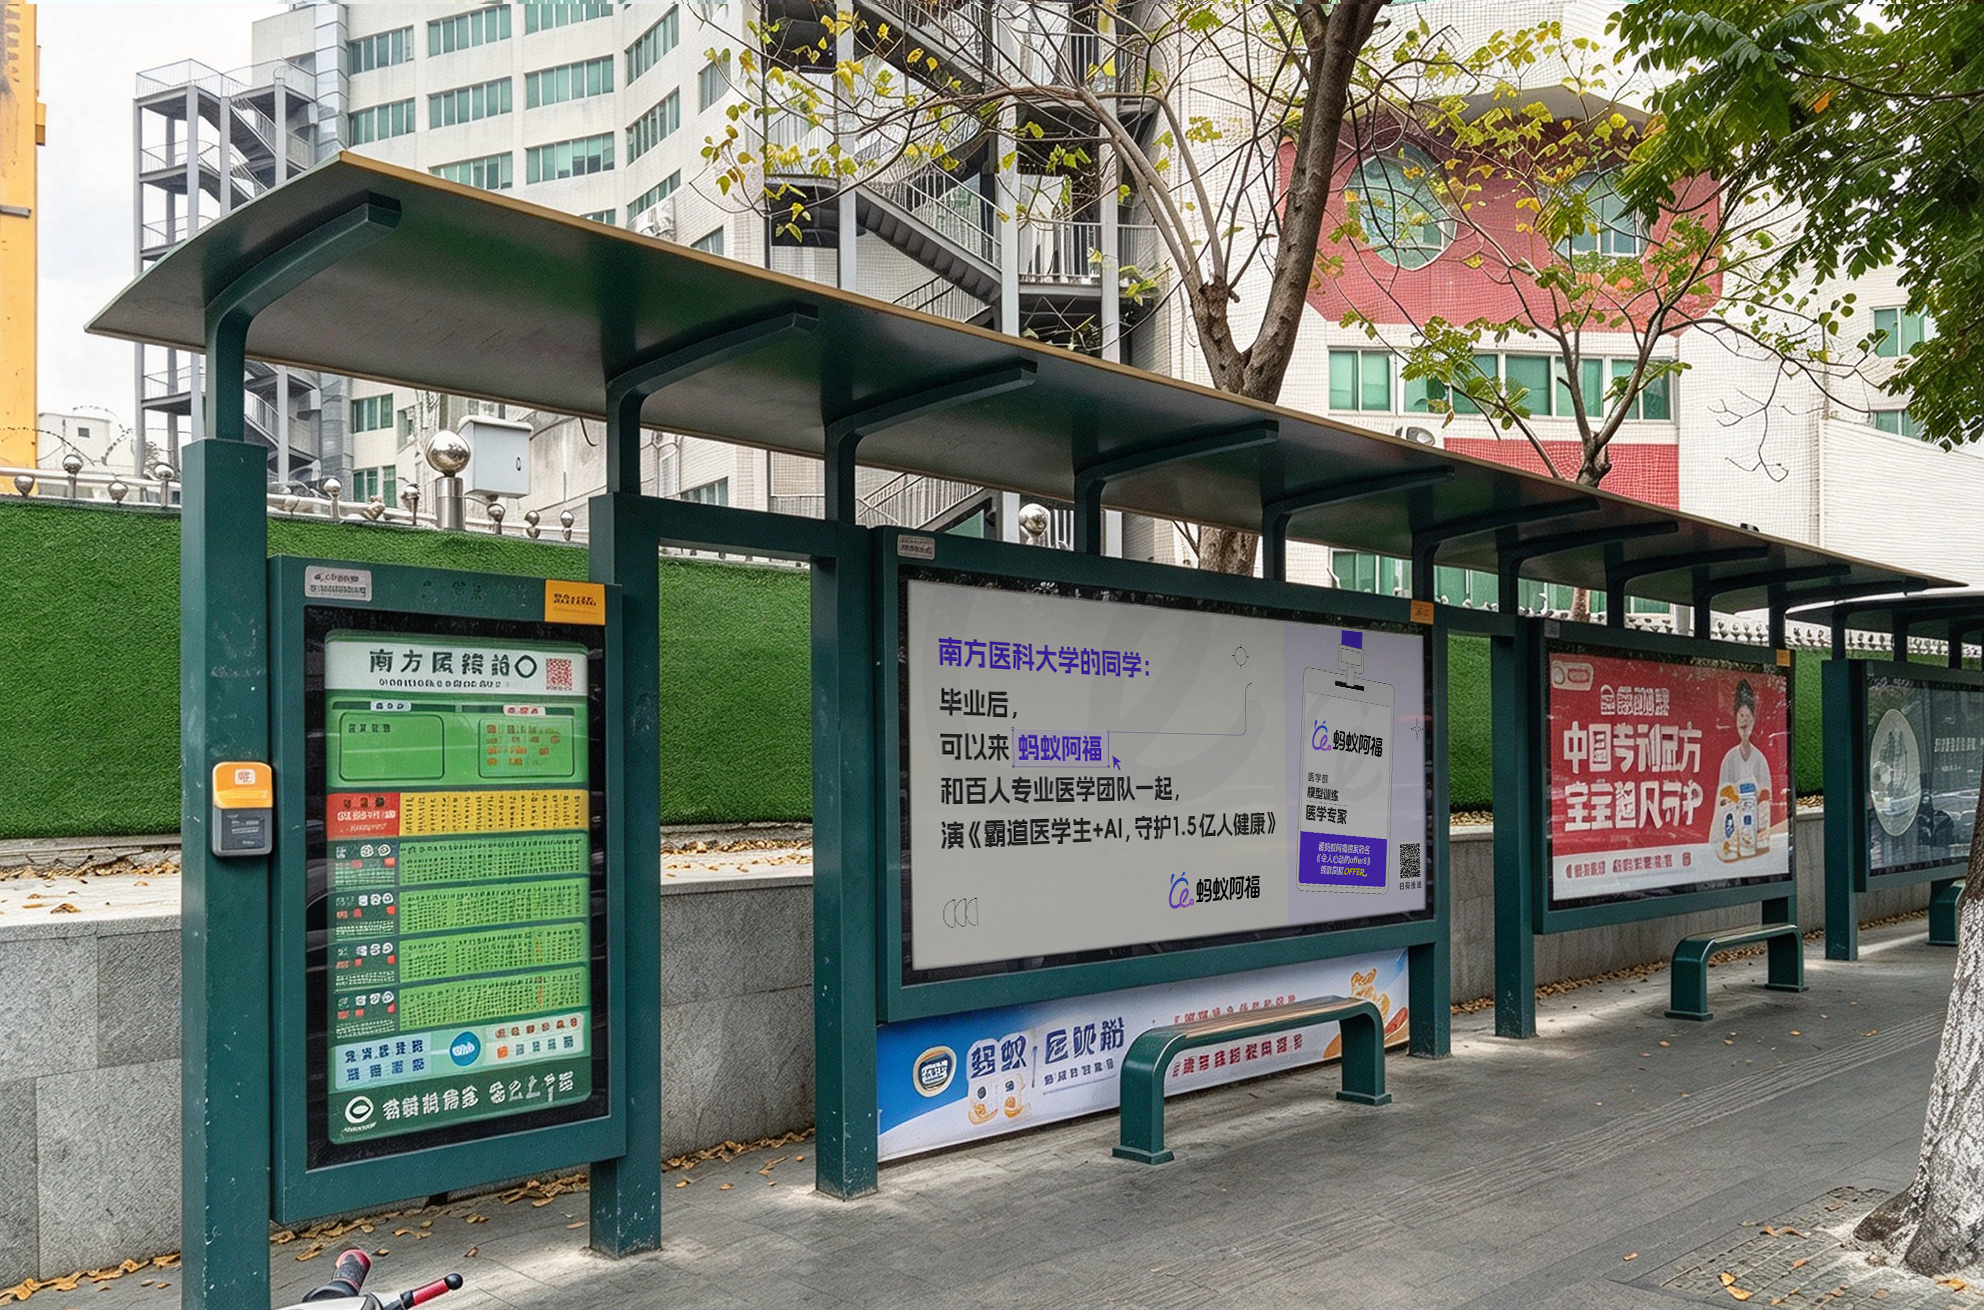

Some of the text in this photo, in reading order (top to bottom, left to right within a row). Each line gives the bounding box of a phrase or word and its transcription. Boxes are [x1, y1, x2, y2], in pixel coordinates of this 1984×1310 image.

[938, 636, 1150, 678] 南方医科大学的同学：
[939, 687, 1018, 719] 毕业后，
[939, 732, 1103, 762] 可以来 蚂蚁阿福
[1332, 729, 1384, 758] 蚂蚁阿福
[940, 775, 1180, 805] 和百人专业医学团队一起，
[1306, 785, 1339, 802] 模型训练
[1305, 804, 1348, 825] 医学专家
[1195, 875, 1261, 903] 蚂蚁阿福
